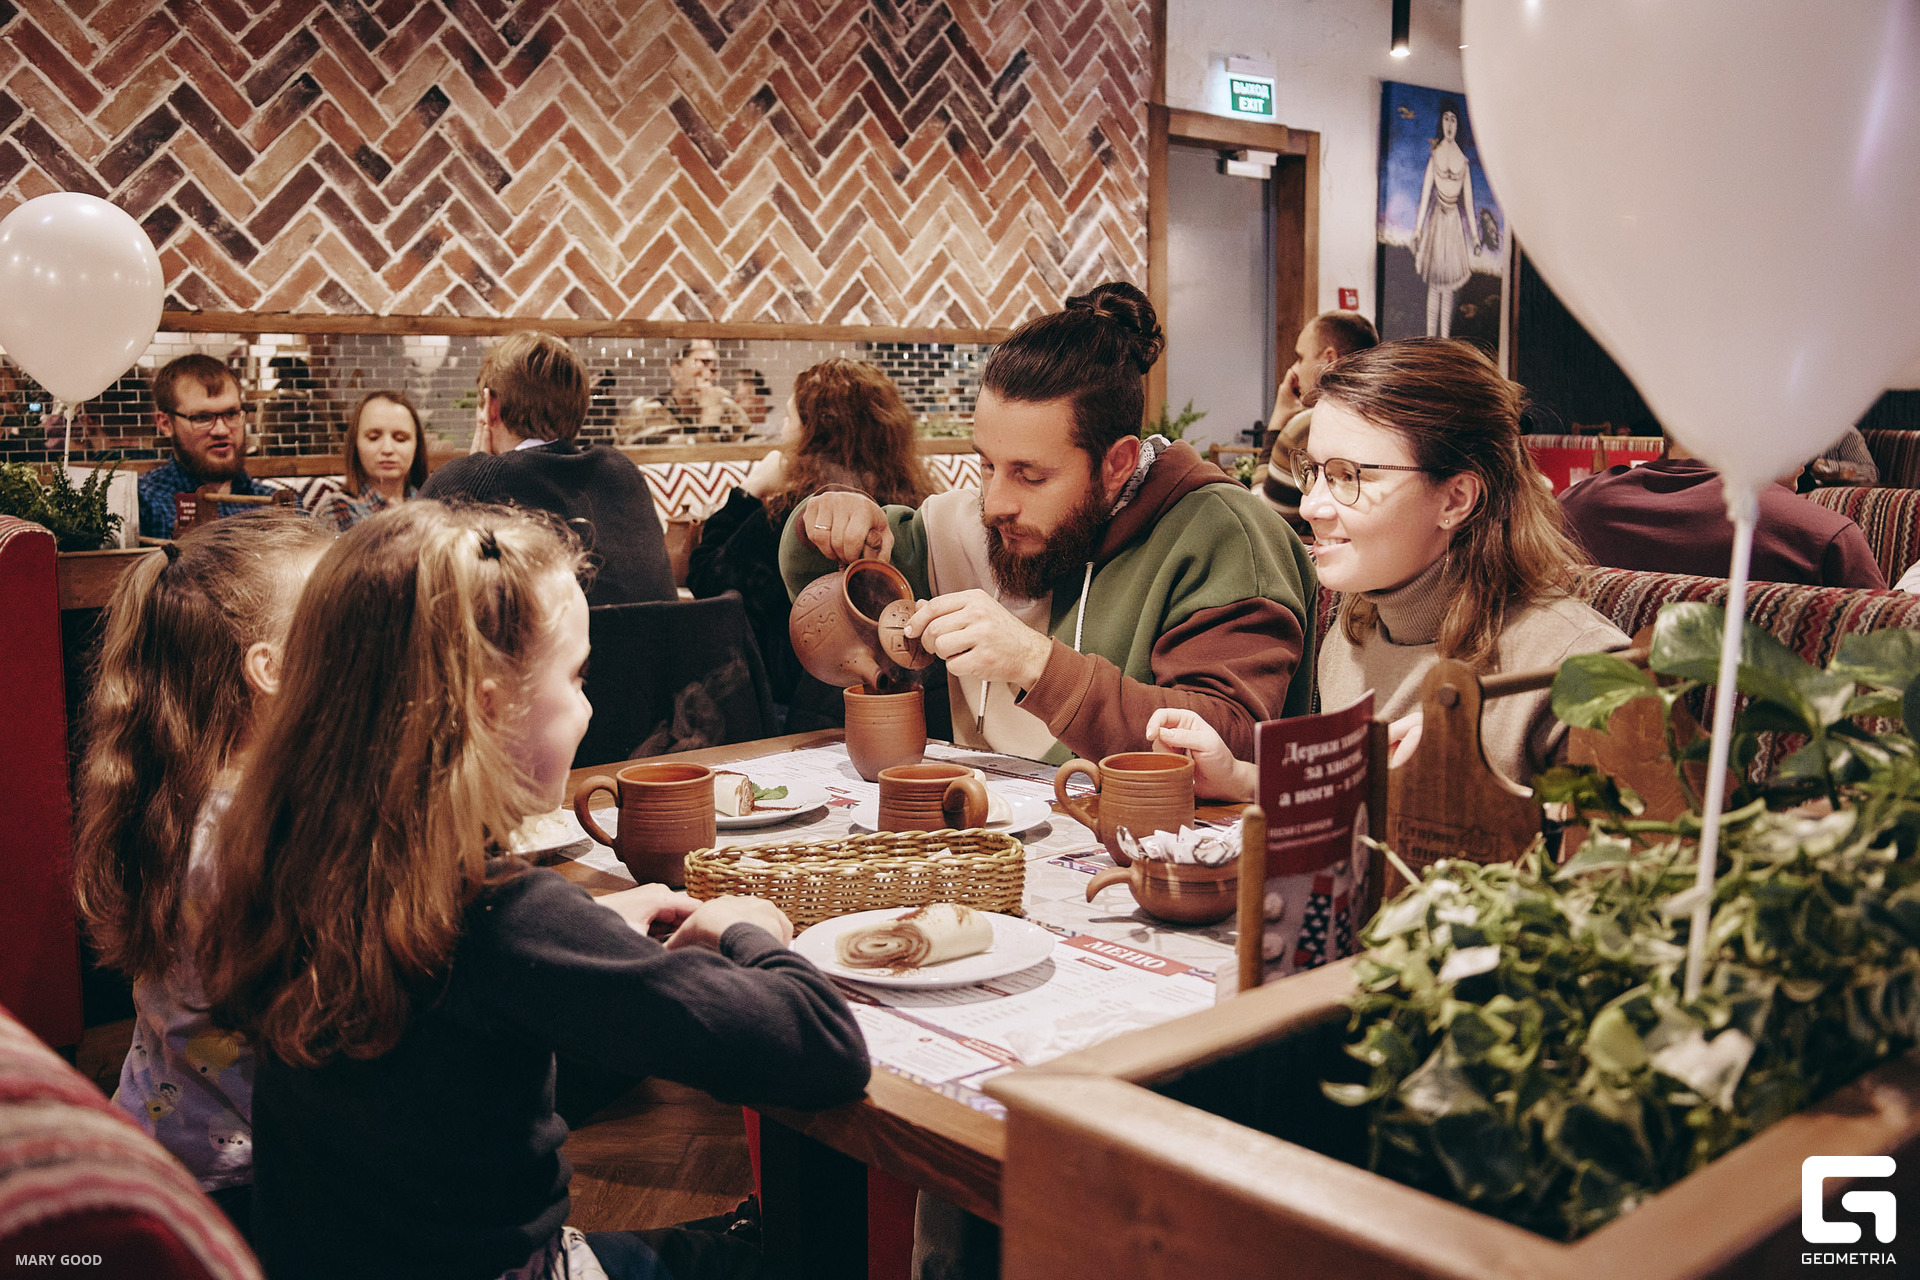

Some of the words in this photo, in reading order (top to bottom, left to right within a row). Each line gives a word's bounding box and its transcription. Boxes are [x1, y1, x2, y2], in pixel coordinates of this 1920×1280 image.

[1232, 80, 1271, 100] ВЫХОД
[1238, 96, 1265, 113] EXIT
[1083, 940, 1168, 969] МЕНЮ
